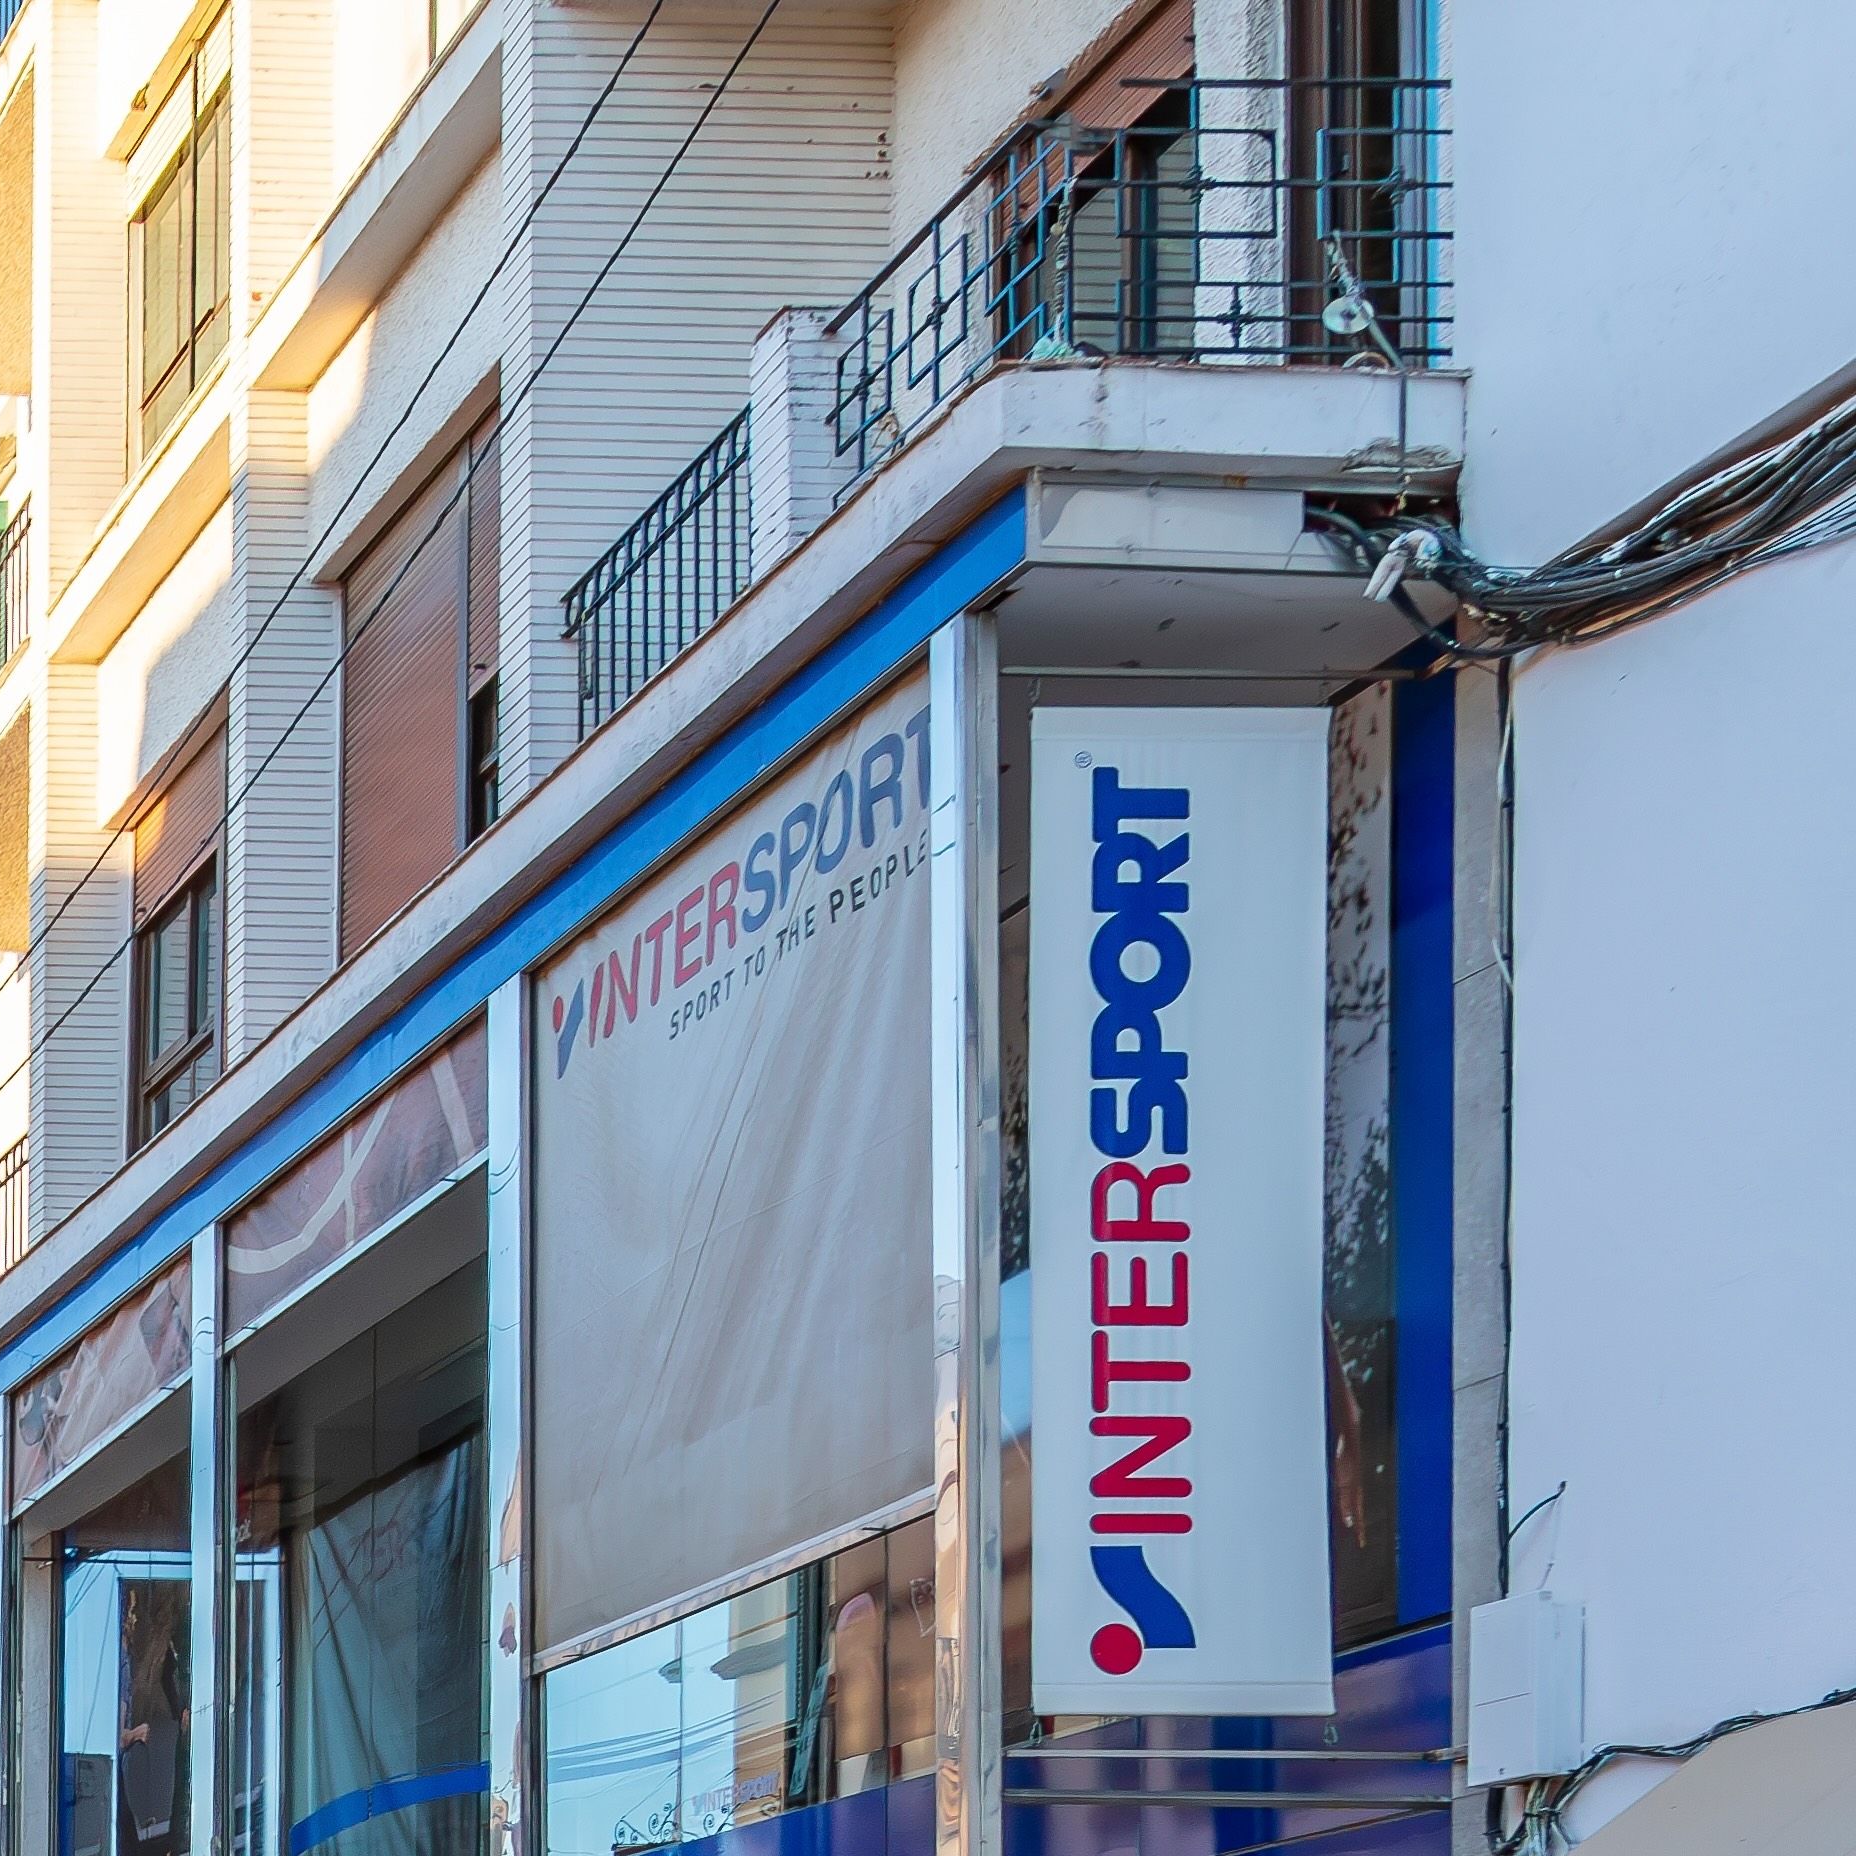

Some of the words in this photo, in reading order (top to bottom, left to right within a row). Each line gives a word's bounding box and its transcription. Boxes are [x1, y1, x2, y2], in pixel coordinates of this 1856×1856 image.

[589, 703, 931, 1048] INTERSPORT
[669, 970, 734, 1041] SPORT
[744, 944, 766, 986] TO
[775, 904, 816, 961] THE
[829, 828, 928, 924] PEOPLE
[1089, 766, 1192, 1534] INTERSPORT
